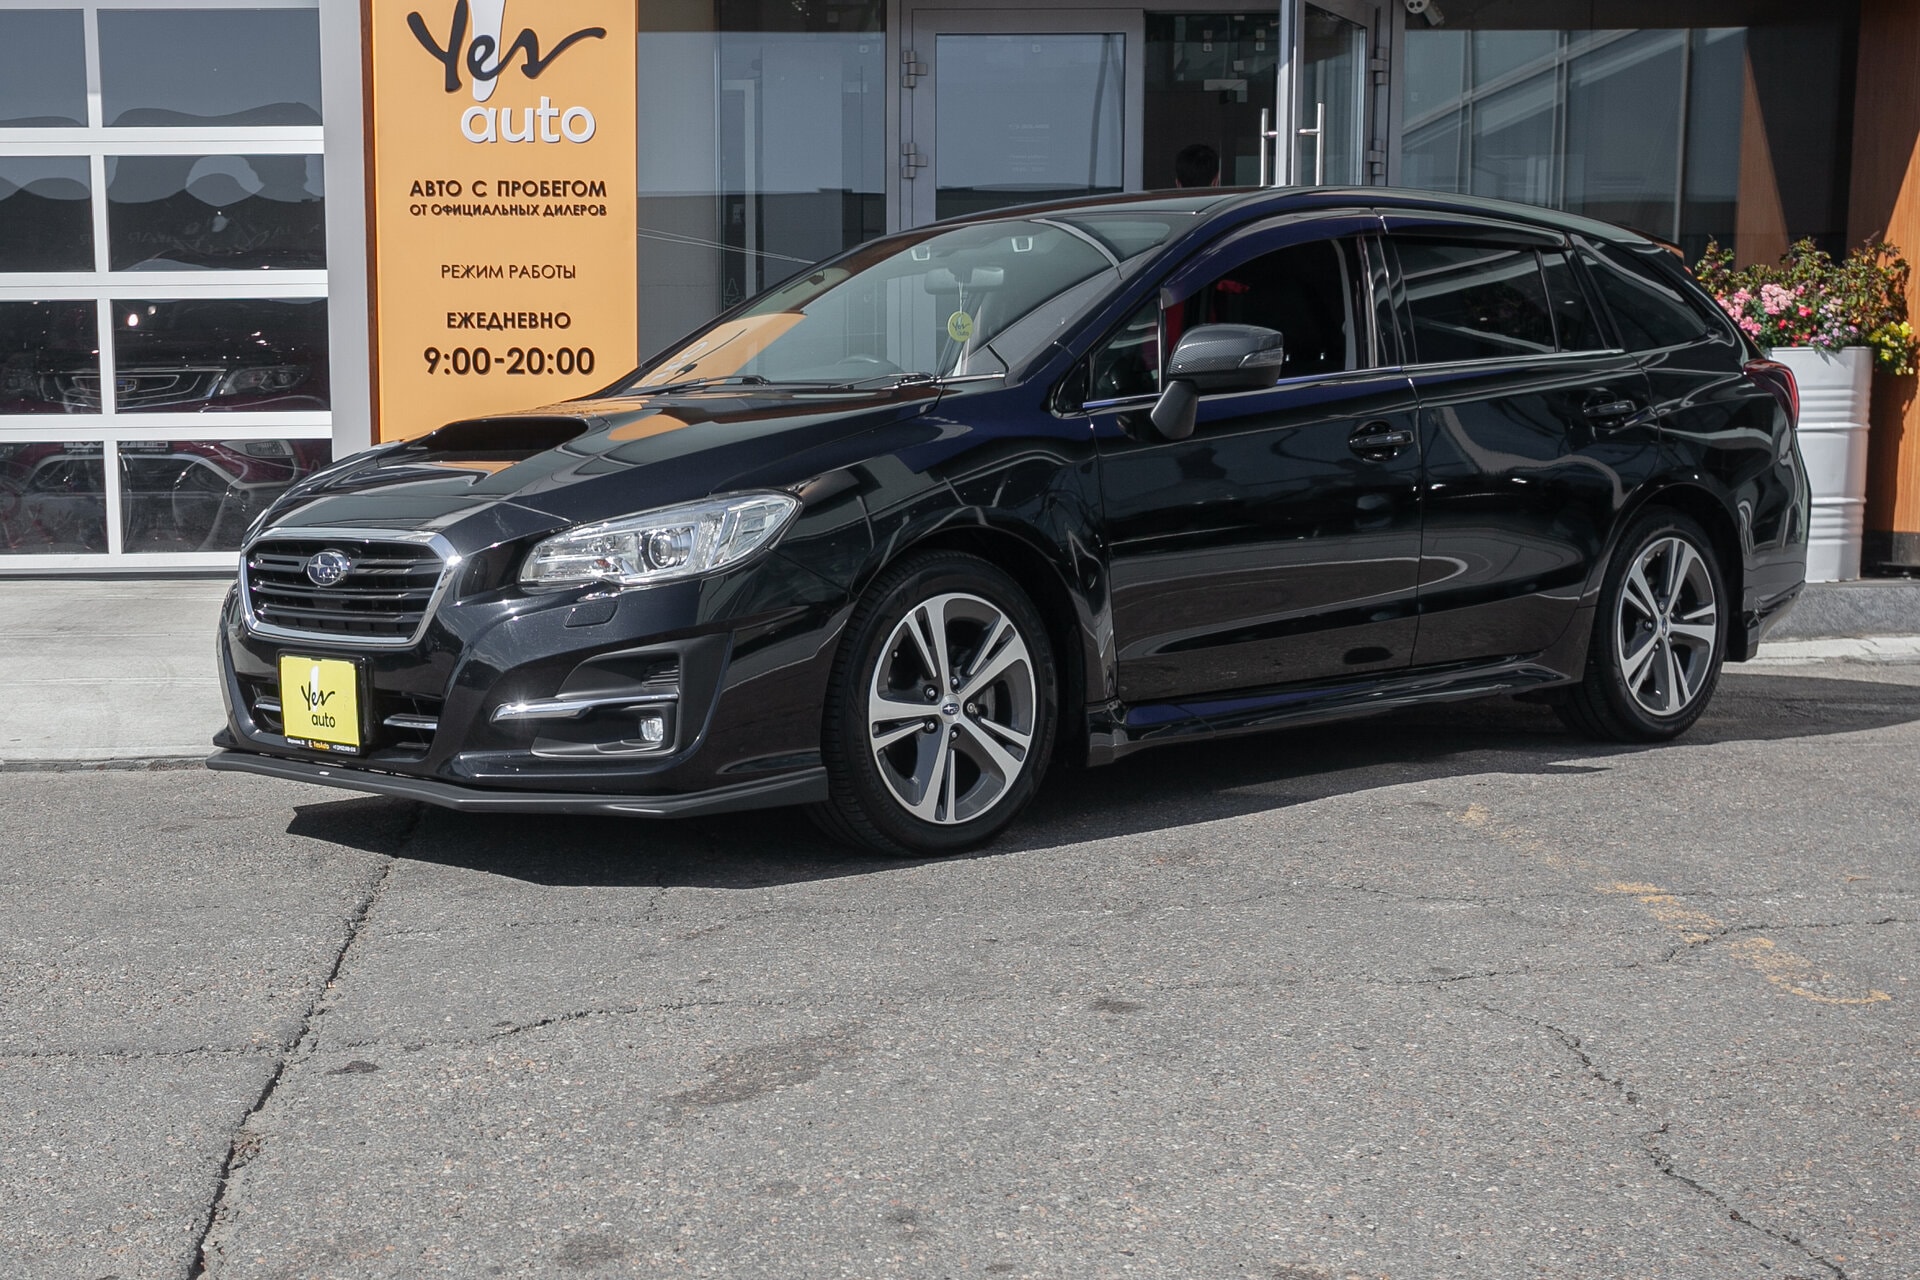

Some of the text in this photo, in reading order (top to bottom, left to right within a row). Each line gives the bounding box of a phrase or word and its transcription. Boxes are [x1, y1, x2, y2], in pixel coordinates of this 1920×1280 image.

[407, 0, 607, 93] Yes
[460, 96, 596, 144] auto
[410, 180, 607, 197] АВТО С ПРОБЕГОМ
[410, 204, 607, 217] ОТ ОФИЦИАЛЬНЫХ ДИЛЕРОВ
[441, 264, 576, 279] РЕЖИМ РАБОТЫ
[447, 312, 571, 331] ЕЖЕДНЕВНО
[424, 347, 595, 375] 9:00-20:00
[301, 681, 335, 711] Yes
[311, 712, 336, 728] auto
